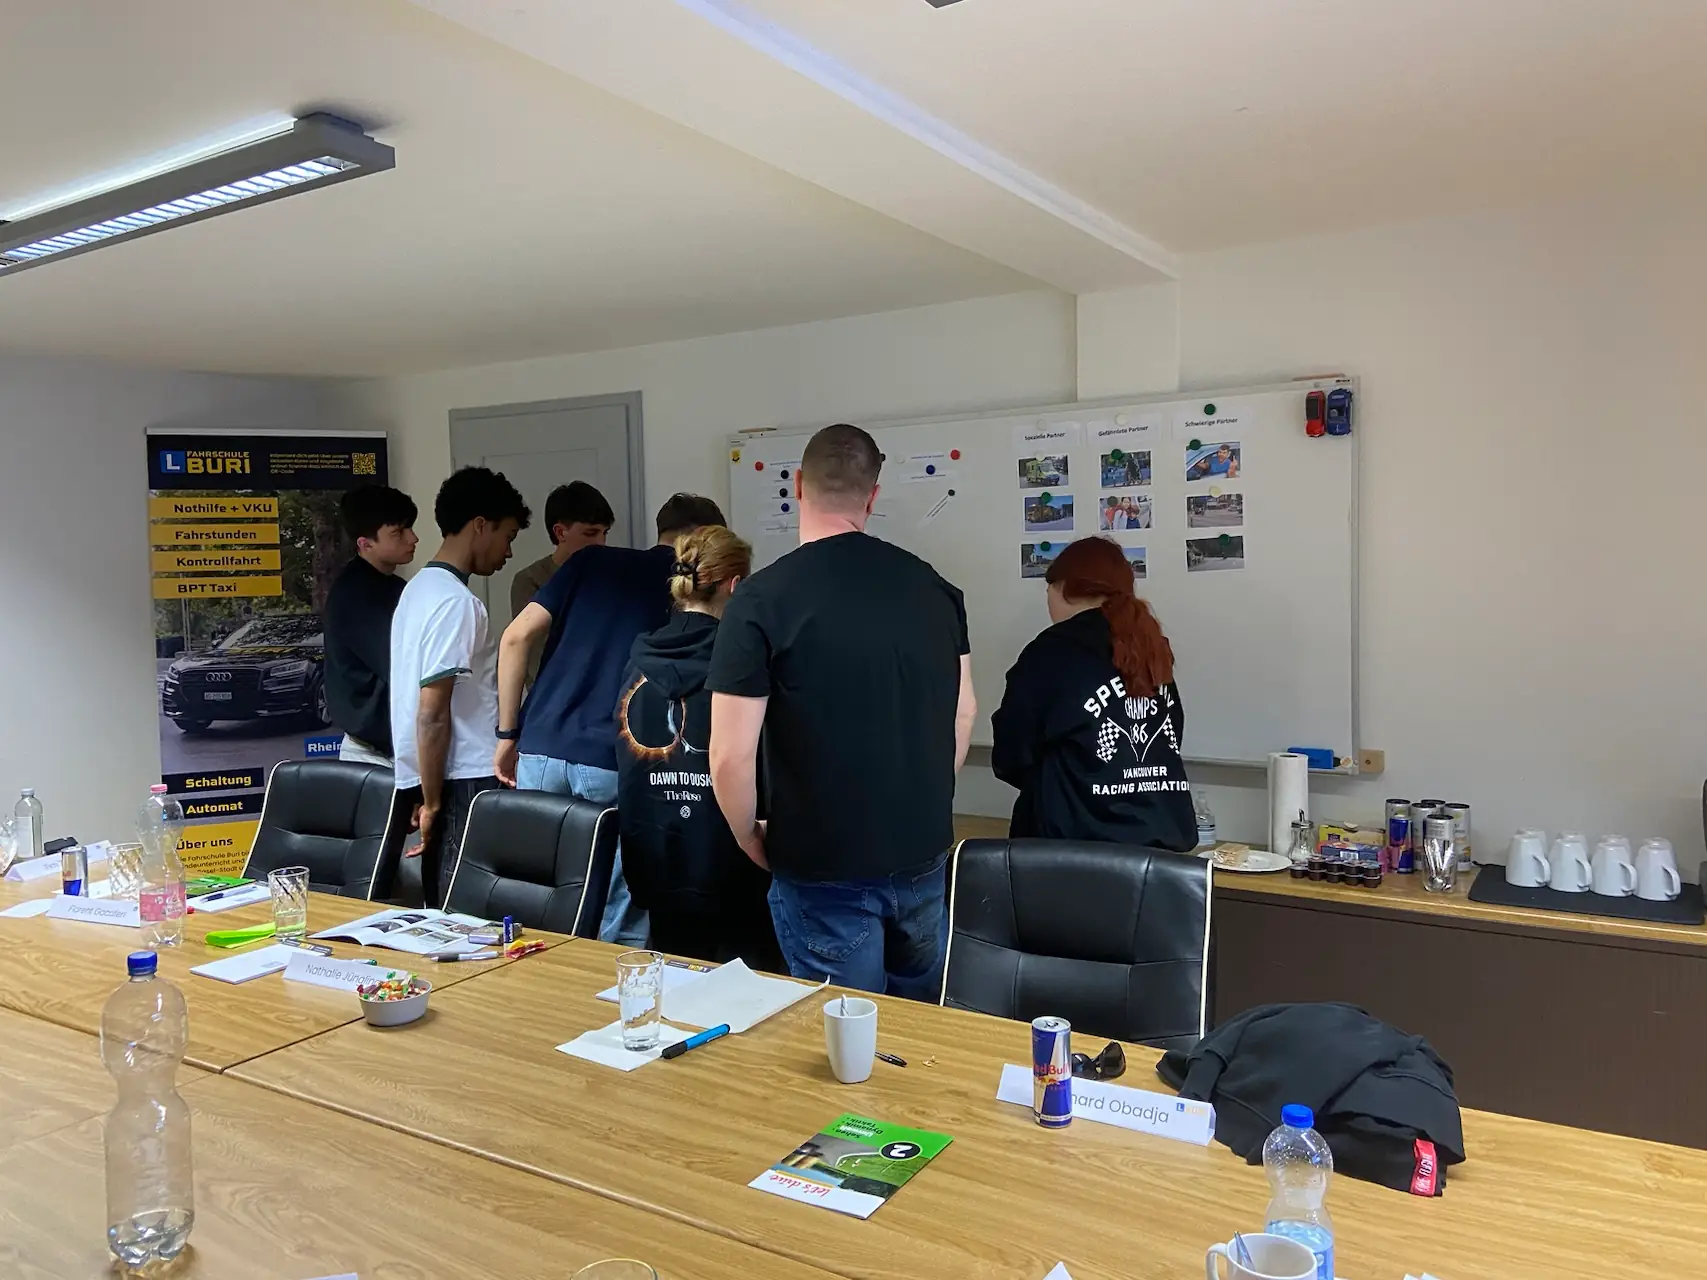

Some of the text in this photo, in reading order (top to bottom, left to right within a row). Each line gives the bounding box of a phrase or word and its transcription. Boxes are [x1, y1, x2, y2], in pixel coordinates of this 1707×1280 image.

[166, 453, 180, 470] L
[187, 458, 251, 474] BURI
[174, 503, 227, 513] Nothilfe
[242, 503, 272, 513] VKU
[175, 530, 257, 540] Fahrstunden
[176, 556, 262, 567] Kontrollfahrt
[177, 582, 237, 593] BPT Taxi
[1124, 697, 1158, 720] CHAMPS
[185, 775, 252, 788] Schaltung
[649, 772, 713, 787] DAWN TO DUSK
[1092, 783, 1135, 795] RACING
[186, 801, 244, 814] Automat
[176, 838, 233, 850] Über uns
[188, 853, 226, 861] Fahrschule
[305, 963, 342, 980] Nathalie
[1109, 1099, 1169, 1125] Obadja
[890, 1144, 913, 1158] 2
[769, 1174, 832, 1199] let's drive
